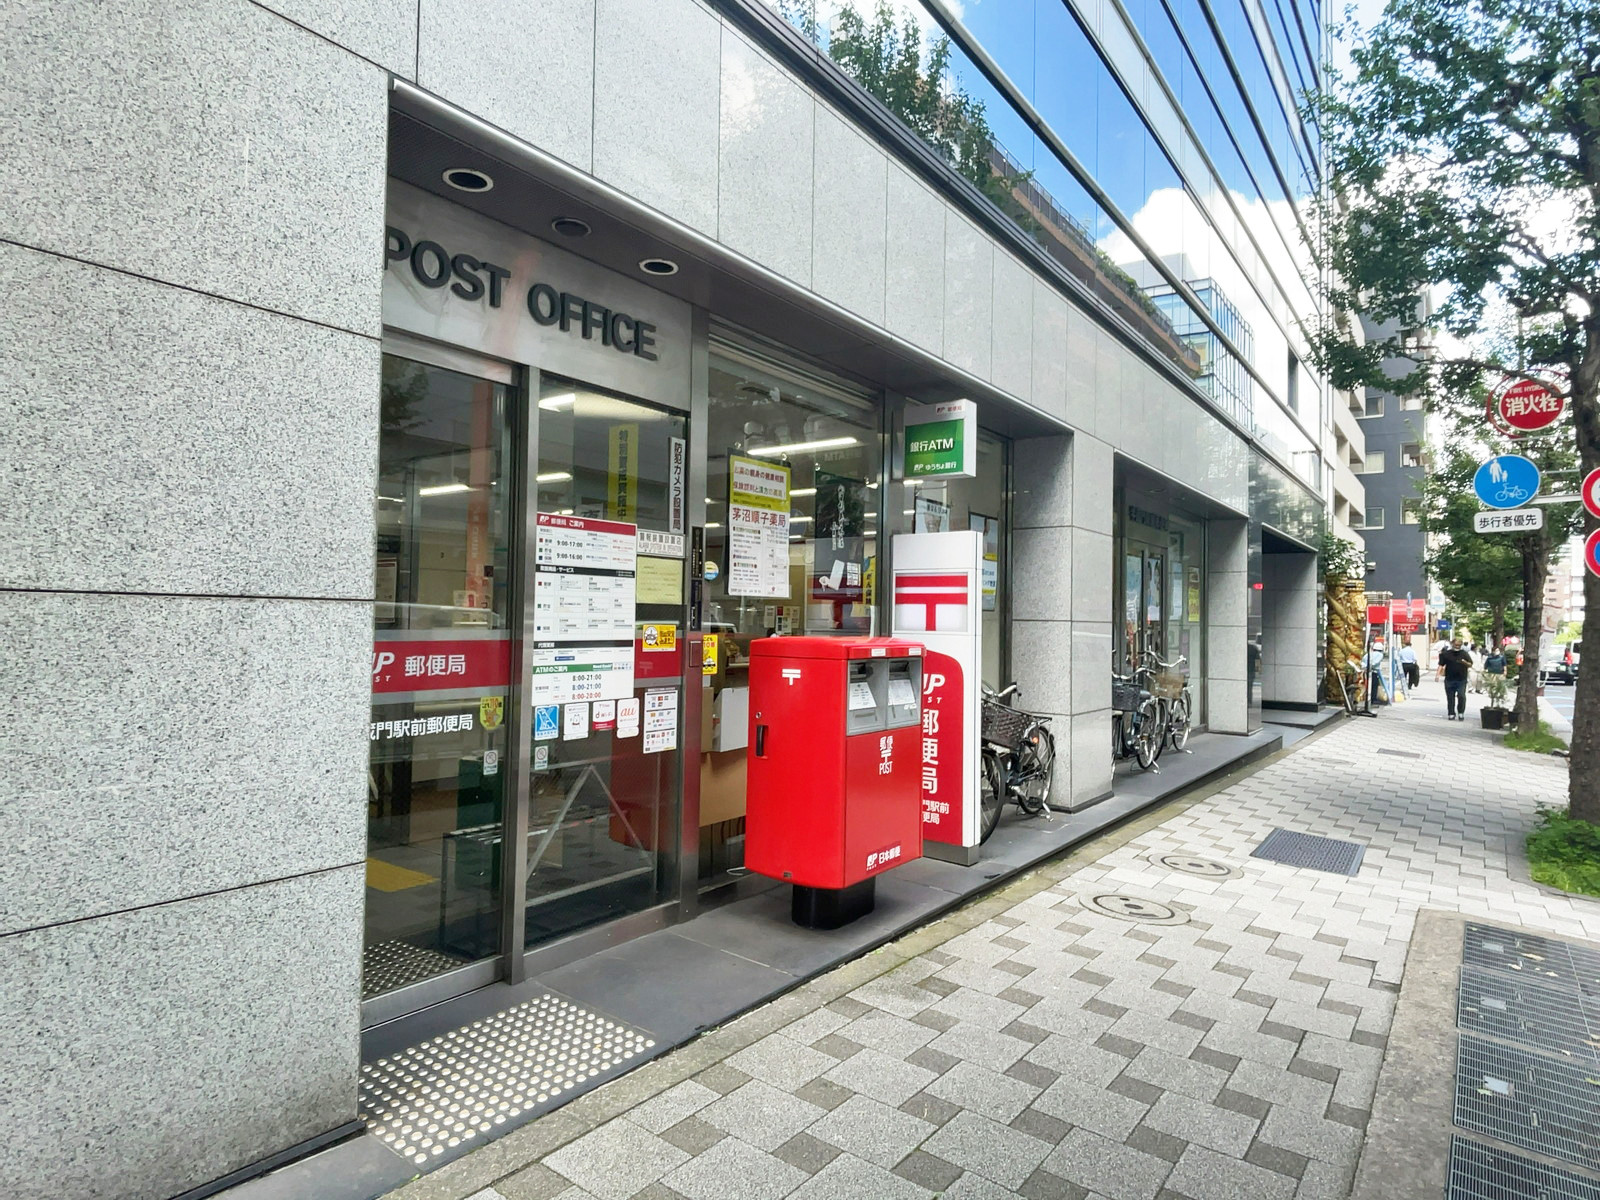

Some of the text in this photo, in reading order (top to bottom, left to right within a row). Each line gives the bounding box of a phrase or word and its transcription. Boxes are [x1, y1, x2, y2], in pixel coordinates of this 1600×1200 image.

[385, 226, 657, 361] POST OFFICE
[1505, 392, 1559, 418] 消火栓
[910, 437, 953, 453] 銀行ATM
[925, 461, 957, 471] ゆうちょ銀行
[732, 507, 786, 528] 茅沼順子薬局
[1479, 514, 1537, 529] 歩行者優先
[556, 540, 583, 548] 9:00-17:00
[556, 552, 583, 560] 9:00-16:00
[405, 654, 466, 677] 郵便局
[572, 674, 602, 682] 8:00-21:00
[572, 683, 602, 691] 8:00-21:00
[571, 692, 601, 700] 8:00-20:00
[620, 707, 637, 717] au
[878, 761, 893, 776] POST
[879, 845, 901, 864] 日本郵便
